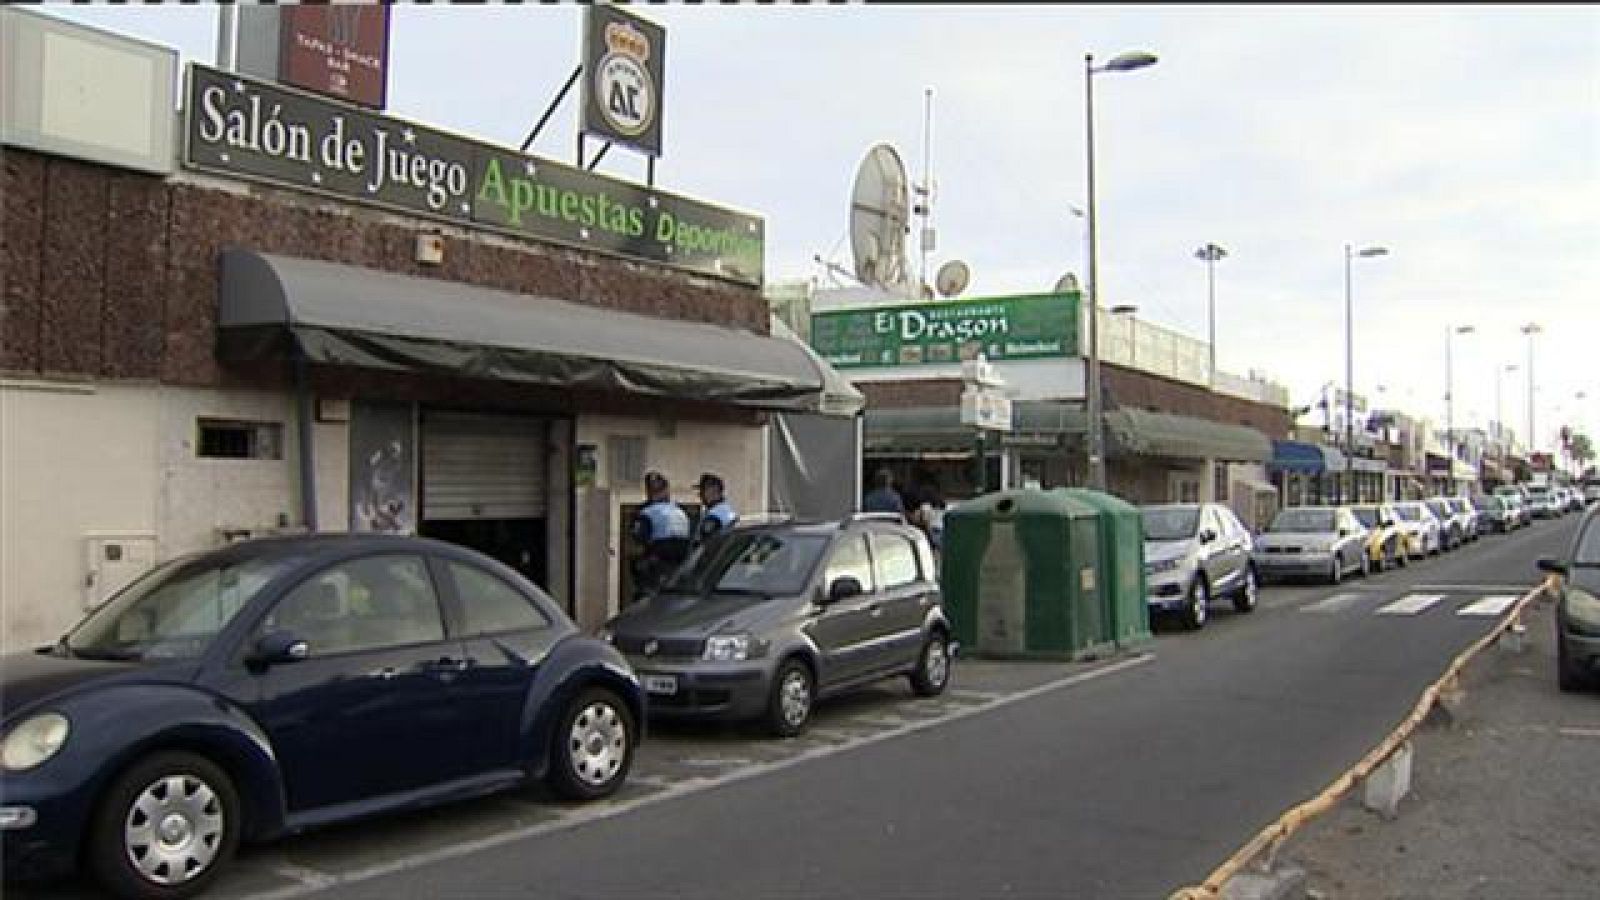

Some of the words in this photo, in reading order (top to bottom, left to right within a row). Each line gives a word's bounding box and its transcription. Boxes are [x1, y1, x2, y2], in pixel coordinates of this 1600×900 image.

[200, 87, 311, 162] Salón
[321, 116, 364, 172] de
[369, 130, 466, 209] Juego
[478, 158, 644, 237] Apuestas
[875, 311, 895, 334] El
[900, 310, 1009, 343] Dragon
